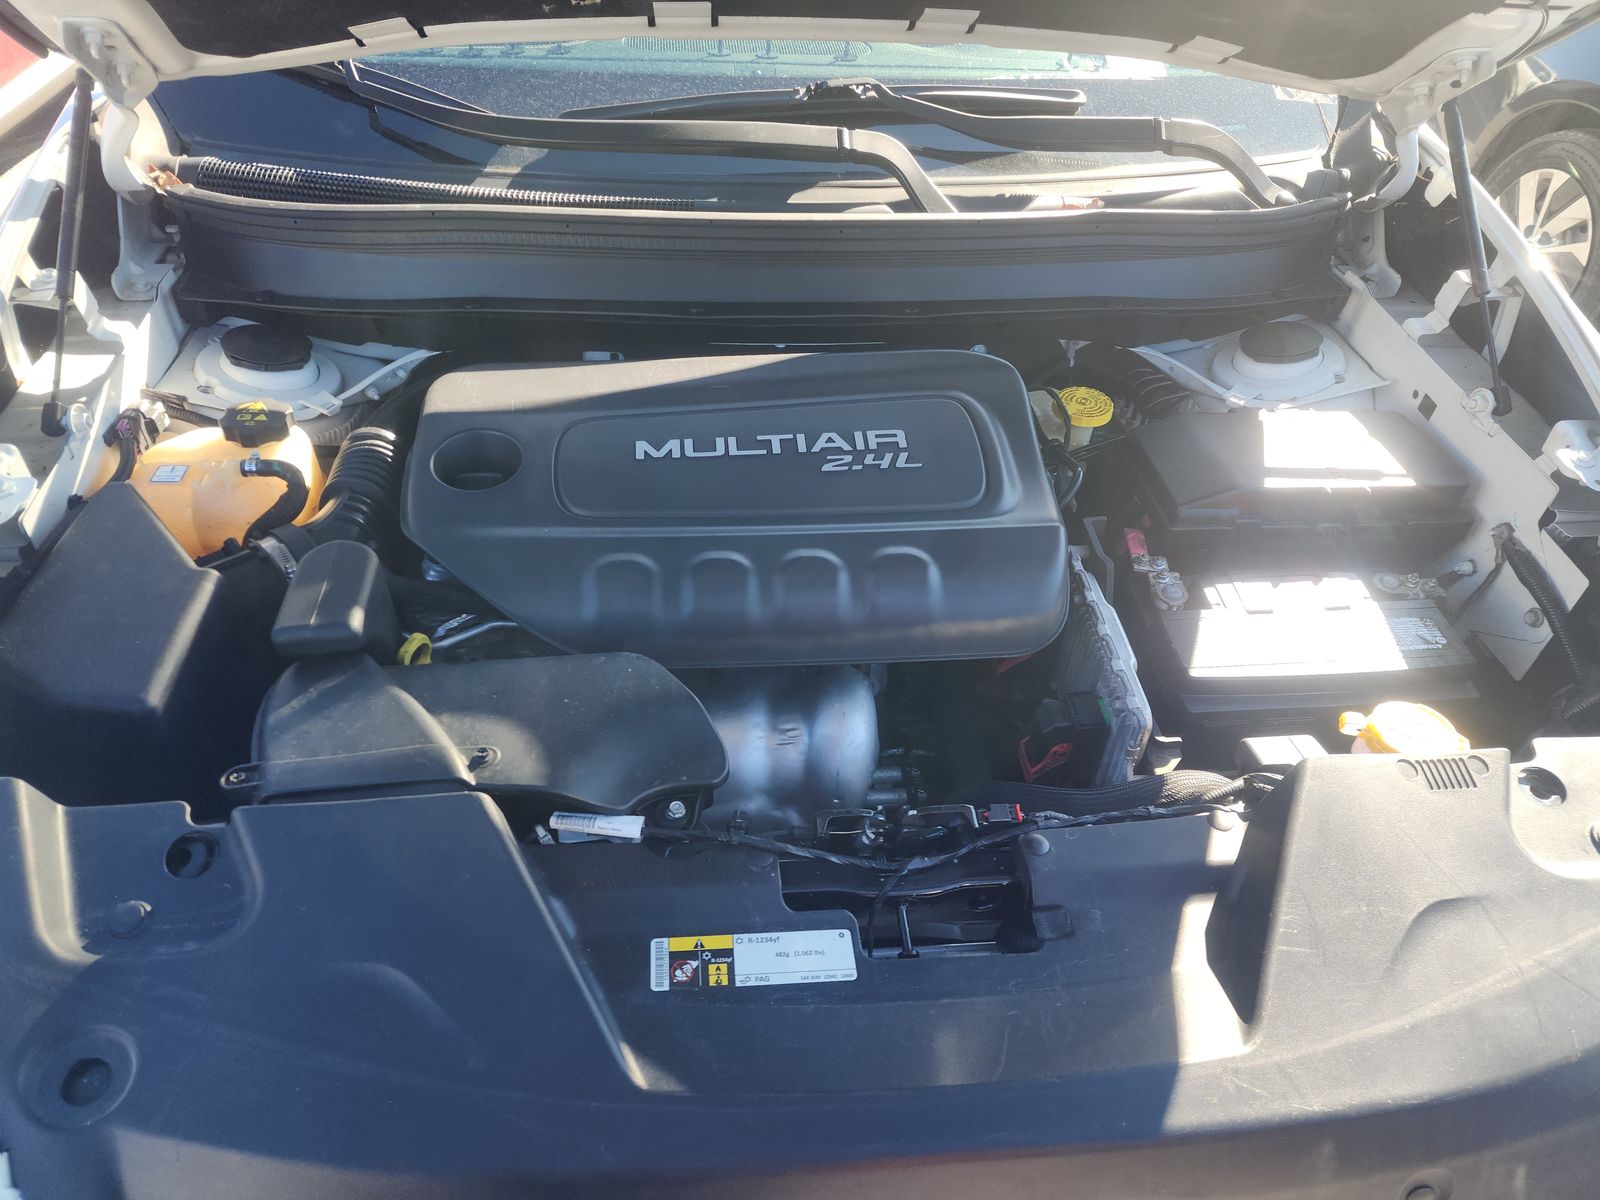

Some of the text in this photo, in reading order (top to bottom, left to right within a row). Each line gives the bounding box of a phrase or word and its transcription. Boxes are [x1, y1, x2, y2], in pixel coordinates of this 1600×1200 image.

[635, 429, 908, 460] MULTIAIR
[821, 452, 923, 472] 2.4L
[748, 936, 780, 944] R-1234yf
[754, 975, 770, 983] PAG
